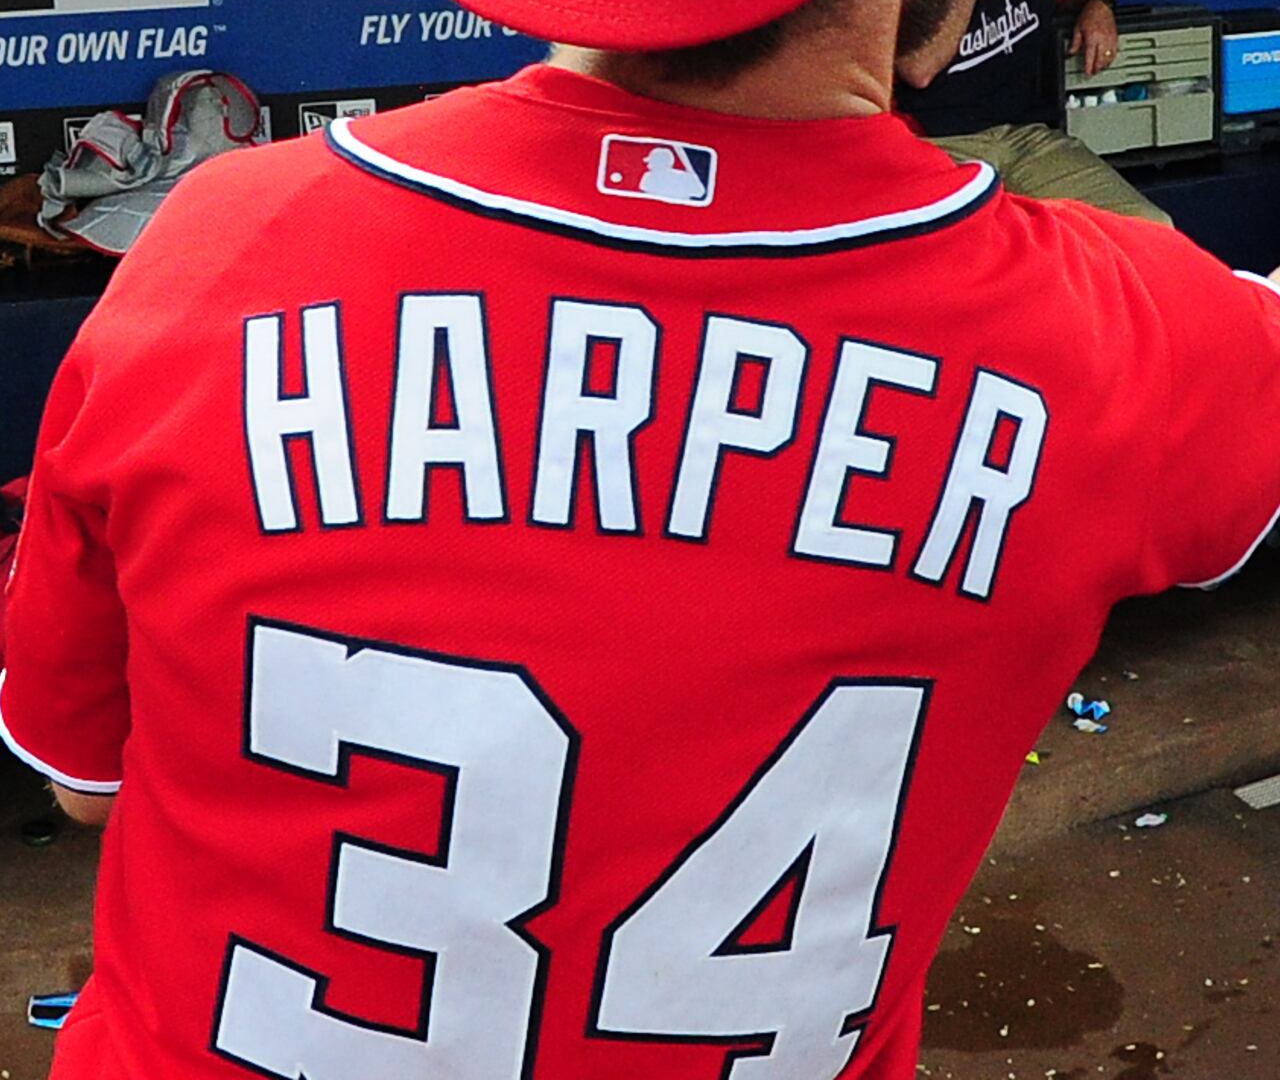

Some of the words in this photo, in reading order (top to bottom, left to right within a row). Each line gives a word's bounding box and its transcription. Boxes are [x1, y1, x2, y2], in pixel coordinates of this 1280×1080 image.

[55, 29, 130, 65] OWN
[135, 24, 208, 60] FLAG
[359, 12, 412, 46] FLY
[418, 9, 495, 42] YOUR
[241, 290, 1050, 603] HARPER
[211, 614, 934, 1080] 34
